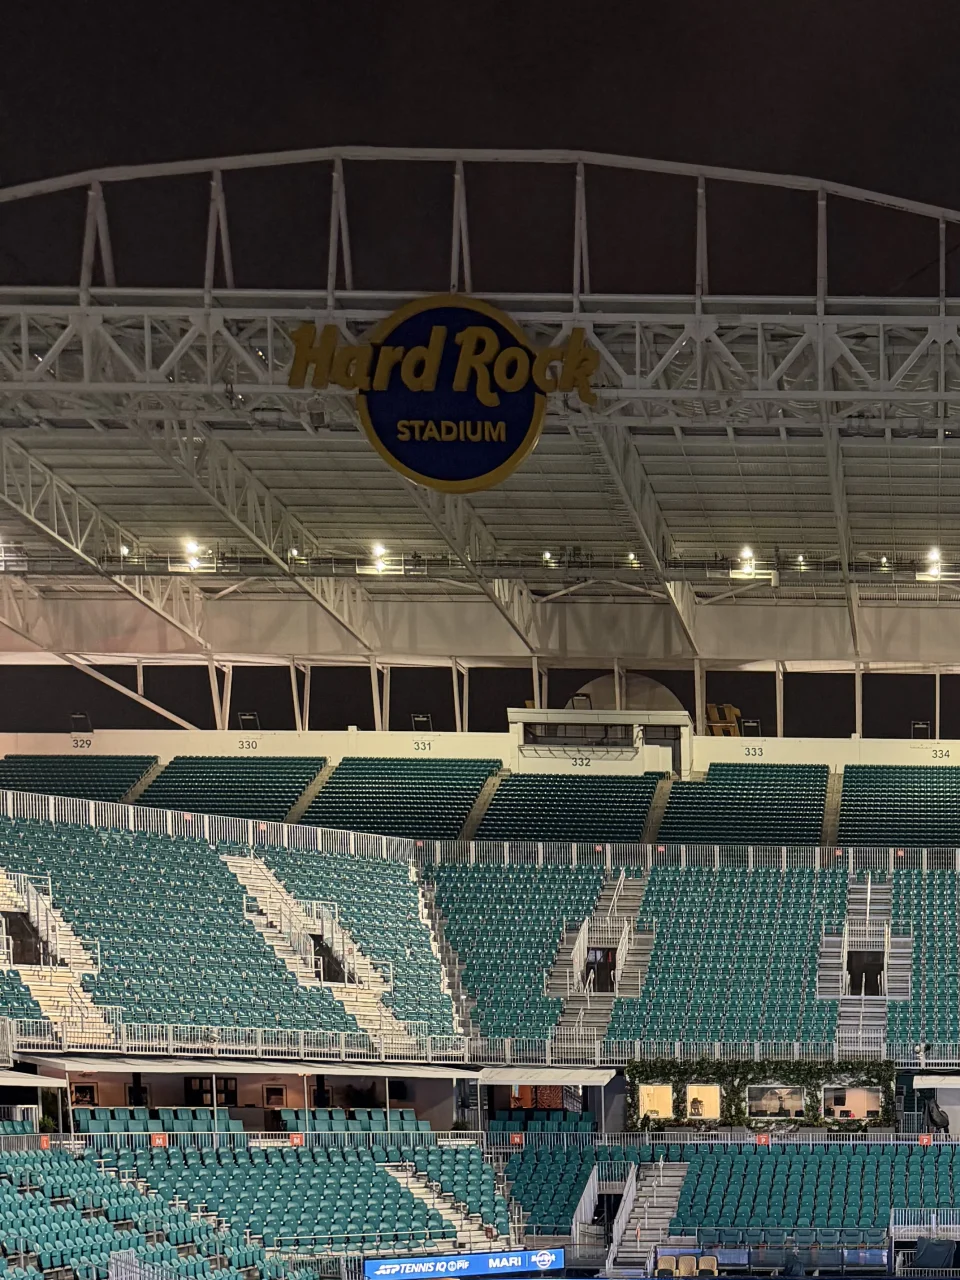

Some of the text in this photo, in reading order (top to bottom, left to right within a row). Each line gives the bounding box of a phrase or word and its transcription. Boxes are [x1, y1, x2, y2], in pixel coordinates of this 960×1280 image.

[288, 325, 599, 408] Hard Rock
[397, 420, 506, 442] STADIUM
[72, 738, 92, 750] 329
[238, 739, 258, 750] 330
[413, 740, 432, 751] 331
[744, 746, 764, 757] 333
[931, 749, 951, 760] 334
[571, 756, 591, 767] 332
[155, 1137, 163, 1145] M
[293, 1136, 301, 1144] M
[761, 1136, 766, 1144] P
[400, 1261, 434, 1274] TENNIS
[435, 1262, 447, 1272] IQ
[488, 1256, 521, 1268] MARI
